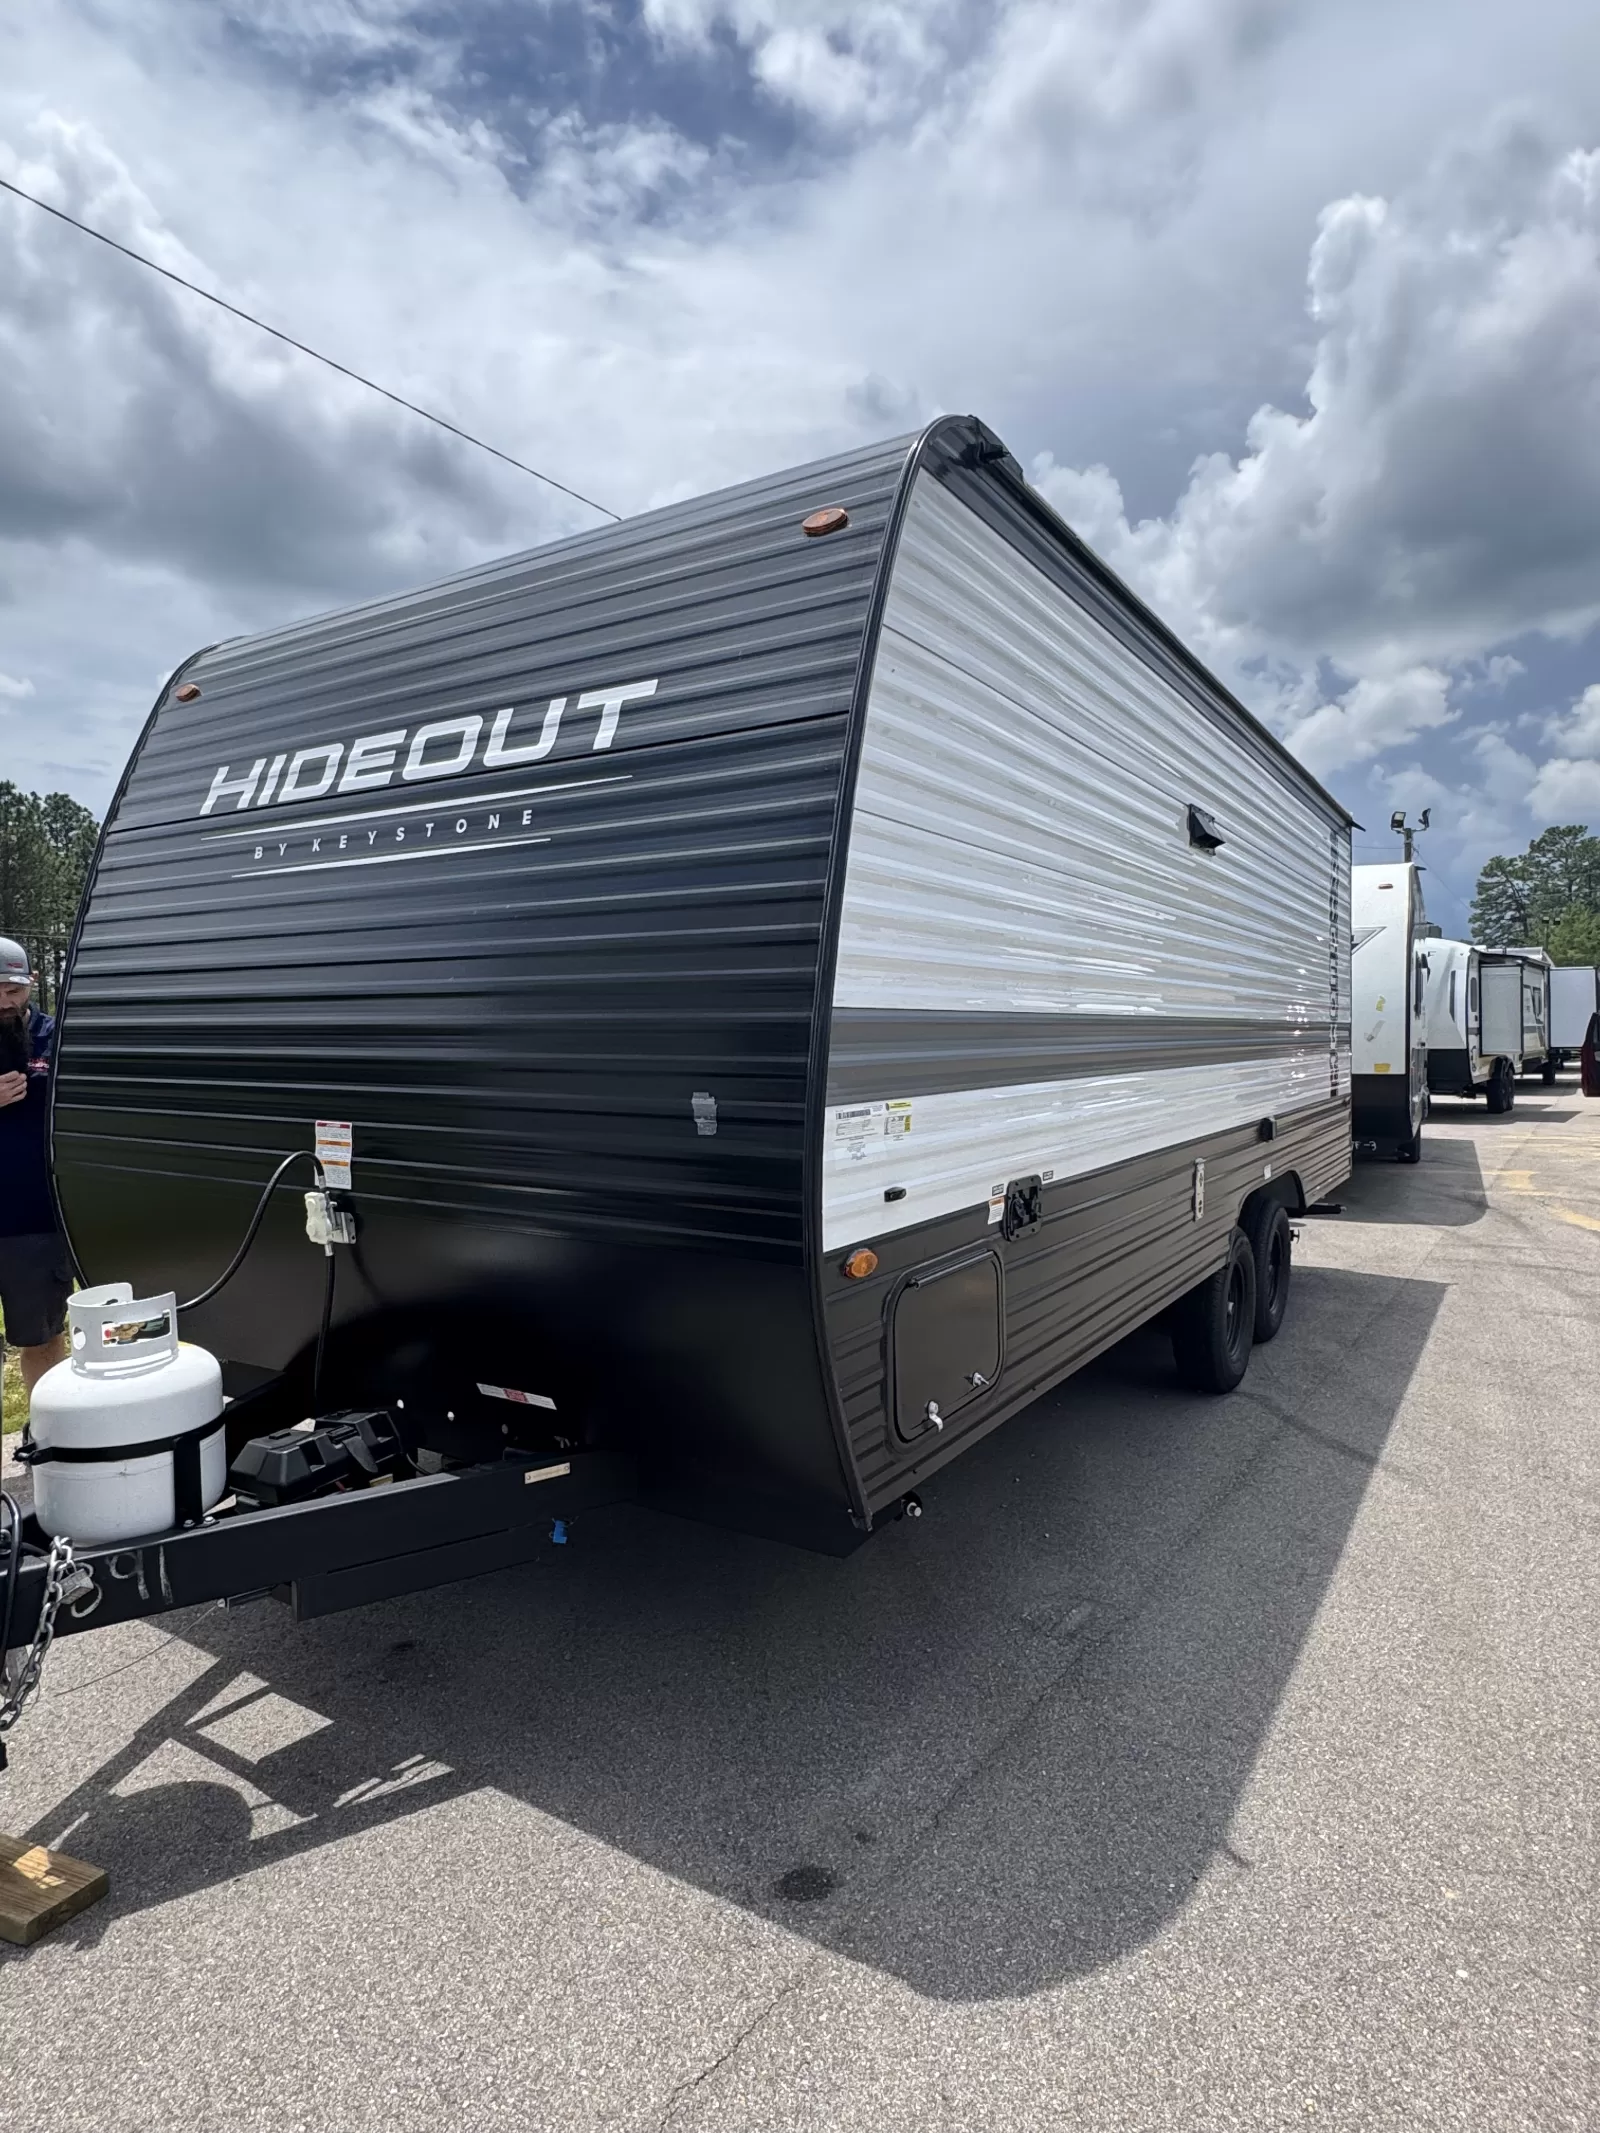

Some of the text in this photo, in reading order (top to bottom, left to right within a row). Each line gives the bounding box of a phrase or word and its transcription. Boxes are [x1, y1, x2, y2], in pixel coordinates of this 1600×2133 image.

[199, 678, 659, 816] HIDEOUT
[253, 809, 533, 860] BY KEYSTONE
